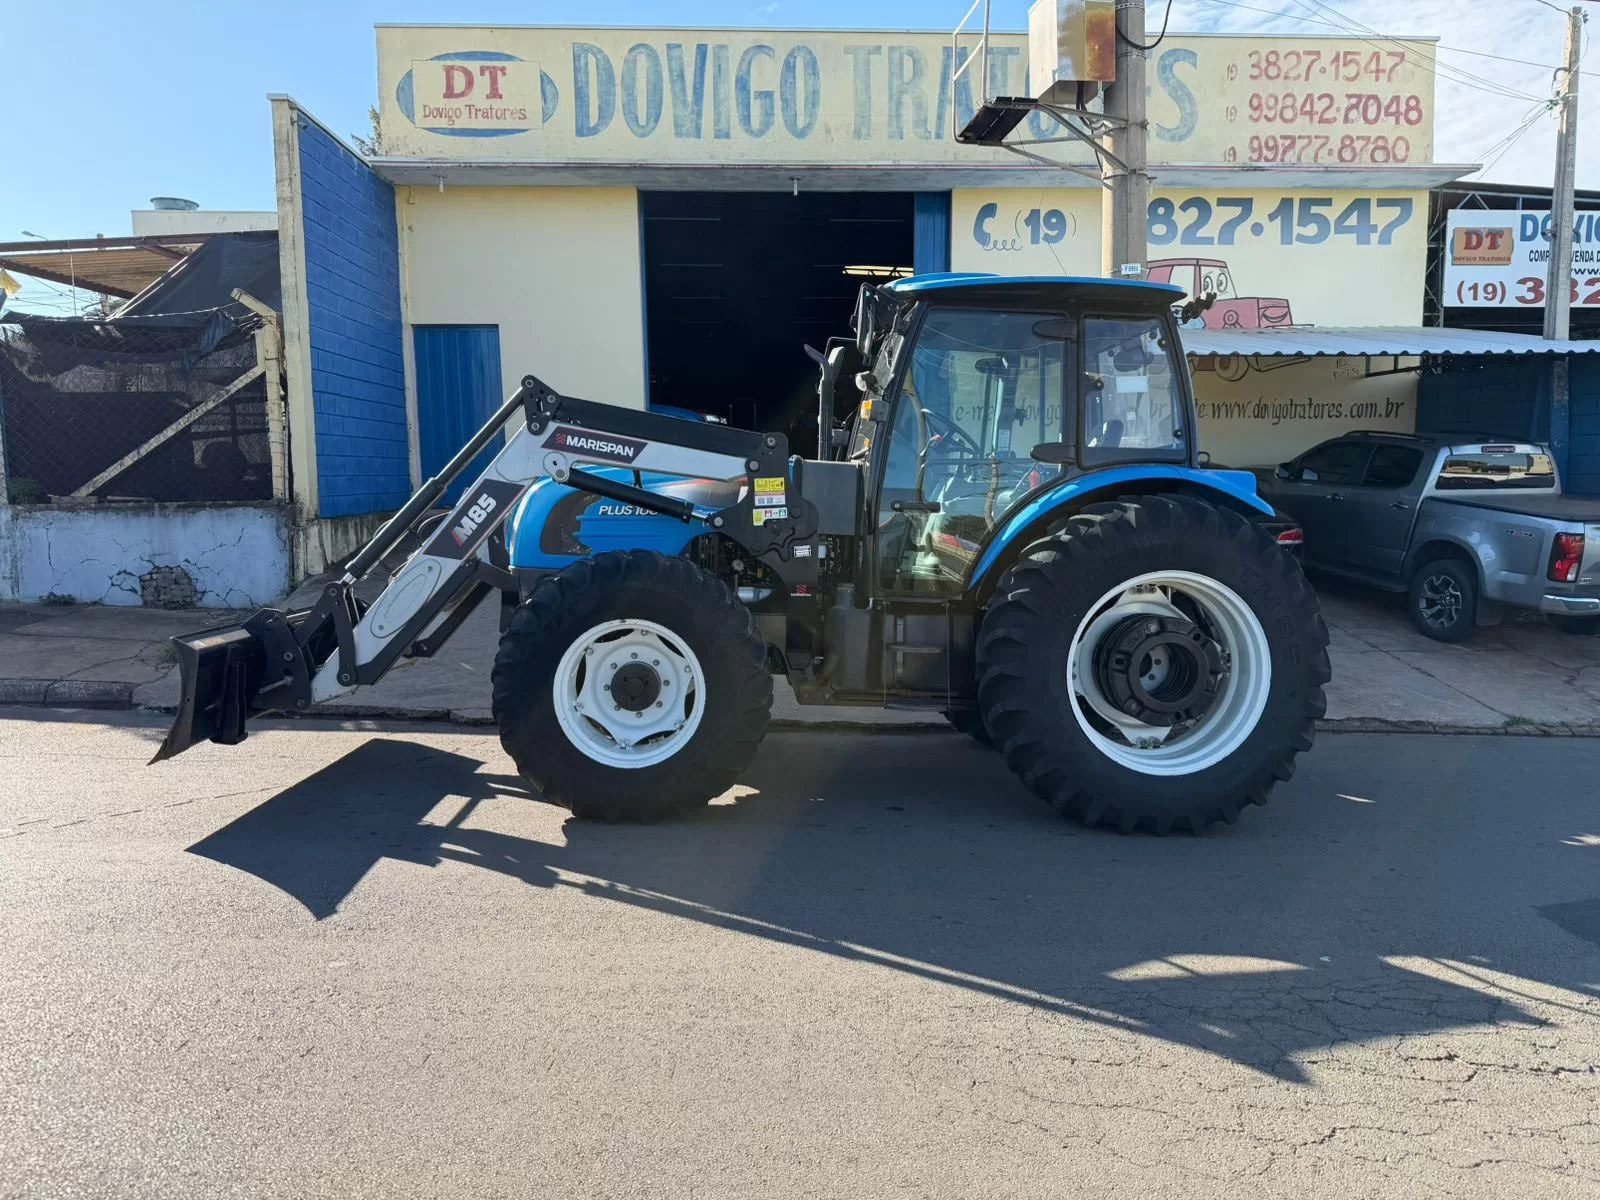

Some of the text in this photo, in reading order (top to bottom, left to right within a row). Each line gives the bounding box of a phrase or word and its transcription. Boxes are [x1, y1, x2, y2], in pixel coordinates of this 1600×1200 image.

[442, 64, 507, 100] DT
[572, 42, 822, 140] DOVIGO
[422, 104, 528, 126] Dovigo Tratores
[1014, 208, 1077, 245] (19)
[1463, 228, 1505, 251] DT
[1457, 280, 1507, 305] (19)
[1211, 395, 1405, 426] www.dovigotratores.com.br
[566, 434, 635, 458] MARISPAN
[452, 492, 497, 546] M85
[599, 504, 633, 516] PLUS
